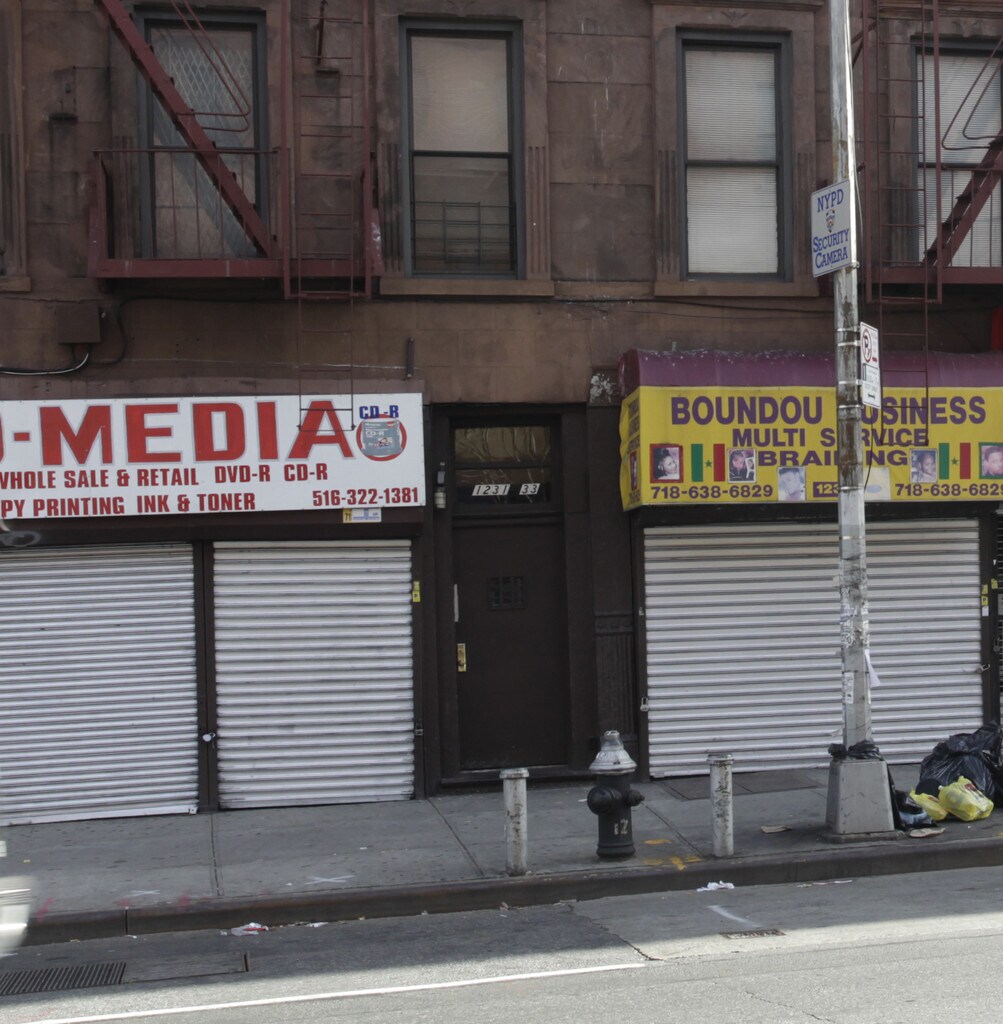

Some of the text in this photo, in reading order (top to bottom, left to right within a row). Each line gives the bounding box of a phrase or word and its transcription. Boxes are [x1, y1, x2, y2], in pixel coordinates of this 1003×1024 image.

[817, 189, 844, 213] NYPD
[813, 228, 850, 253] SECURITY
[815, 246, 848, 269] CAMERA
[671, 396, 822, 425] BOUNDOU
[850, 395, 986, 425] USINESS
[0, 400, 353, 466] -MEDIA
[732, 427, 928, 447] MULTI SRVICE
[758, 450, 908, 466] BRAING
[64, 469, 109, 488] SALE
[117, 469, 130, 487] &
[137, 467, 200, 487] RETAIL
[215, 465, 271, 484] DVD-R
[284, 462, 328, 482] CD-R
[312, 487, 419, 506] 516-322-1381
[476, 484, 538, 495] 1231 33
[651, 484, 773, 500] 718-638-6829
[33, 496, 125, 517] PRINTING
[137, 494, 169, 513] INK
[177, 494, 190, 512] &
[197, 492, 256, 511] TONER
